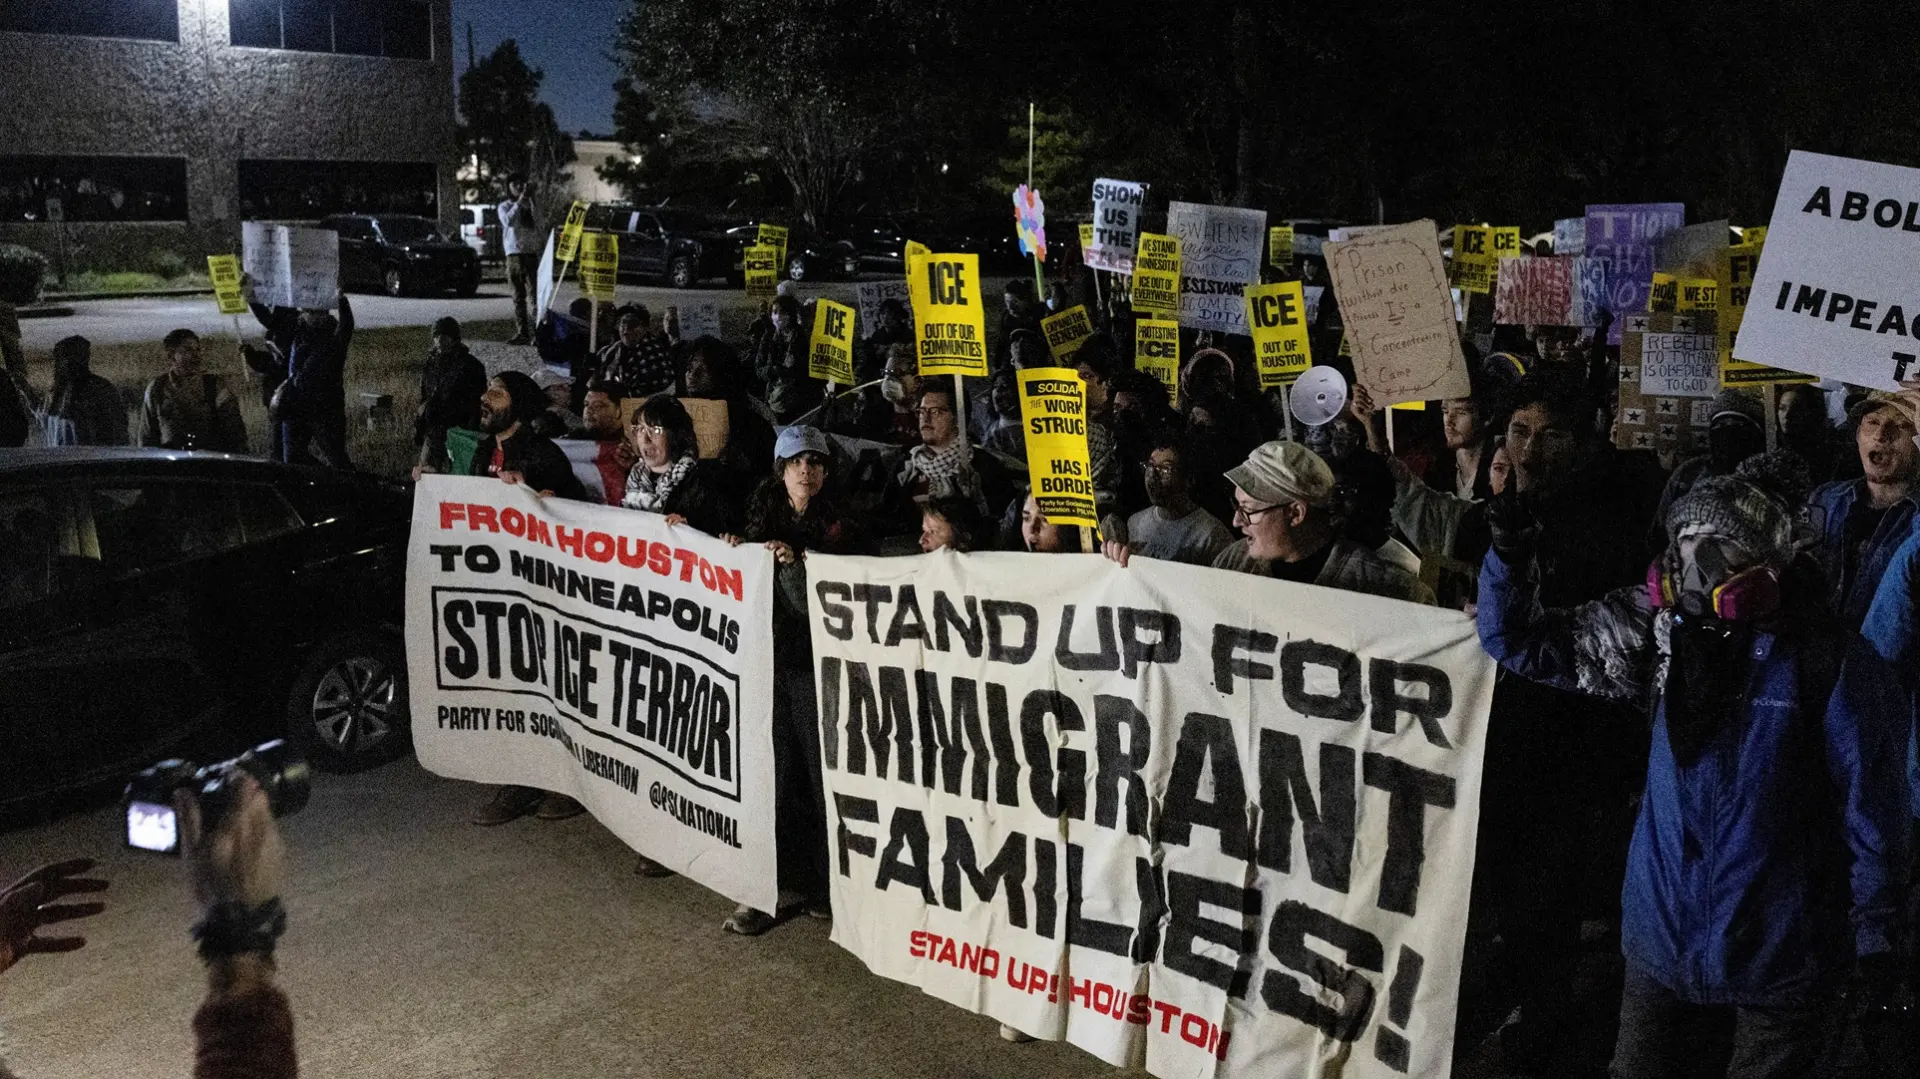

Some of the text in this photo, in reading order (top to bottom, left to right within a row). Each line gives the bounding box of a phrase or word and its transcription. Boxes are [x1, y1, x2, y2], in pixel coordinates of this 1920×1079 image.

[1094, 184, 1142, 205] SHOW
[1104, 208, 1128, 226] US
[1096, 228, 1133, 248] THE
[1142, 239, 1177, 254] WE STAND
[1462, 230, 1486, 255] ICE
[747, 260, 775, 270] ICE
[1139, 257, 1178, 272] MINNESOTA!
[1348, 250, 1406, 284] Prison
[927, 261, 968, 306] ICE
[1139, 276, 1173, 290] ICE OUT OF
[1198, 308, 1243, 325] DUTY
[1250, 293, 1298, 328] ICE
[825, 305, 847, 342] ICE
[925, 323, 975, 340] OUT OF OUR
[1138, 325, 1177, 340] PROTESTING
[816, 343, 831, 355] OUT
[837, 347, 848, 359] OUR
[921, 340, 982, 357] COMMUNITIES
[1138, 340, 1176, 358] ICE
[1263, 339, 1297, 354] OUT OF
[1261, 353, 1306, 368] HOUSTON
[1644, 350, 1664, 364] TO
[1645, 365, 1656, 377] IS
[1665, 378, 1708, 391] TO GOD
[1030, 416, 1084, 435] STRUG
[1051, 459, 1081, 475] HAS
[1041, 478, 1092, 495] BORDE
[439, 501, 743, 602] FROM HOUSTON
[430, 544, 740, 655] TO MINNEAPOLIS
[815, 580, 1455, 750] STAND UP FOR
[444, 599, 548, 688] STOP
[554, 618, 602, 720] ICE
[609, 638, 732, 782] TERROR
[437, 705, 526, 733] PARTY FOR
[582, 745, 639, 795] LIBERATION
[819, 656, 1456, 917] IMMIGRANT
[649, 780, 742, 849] @PSLNATIONAL
[833, 791, 1424, 1073] FAMILIES!
[909, 929, 1231, 1062] STAND UP! HOUSTON
